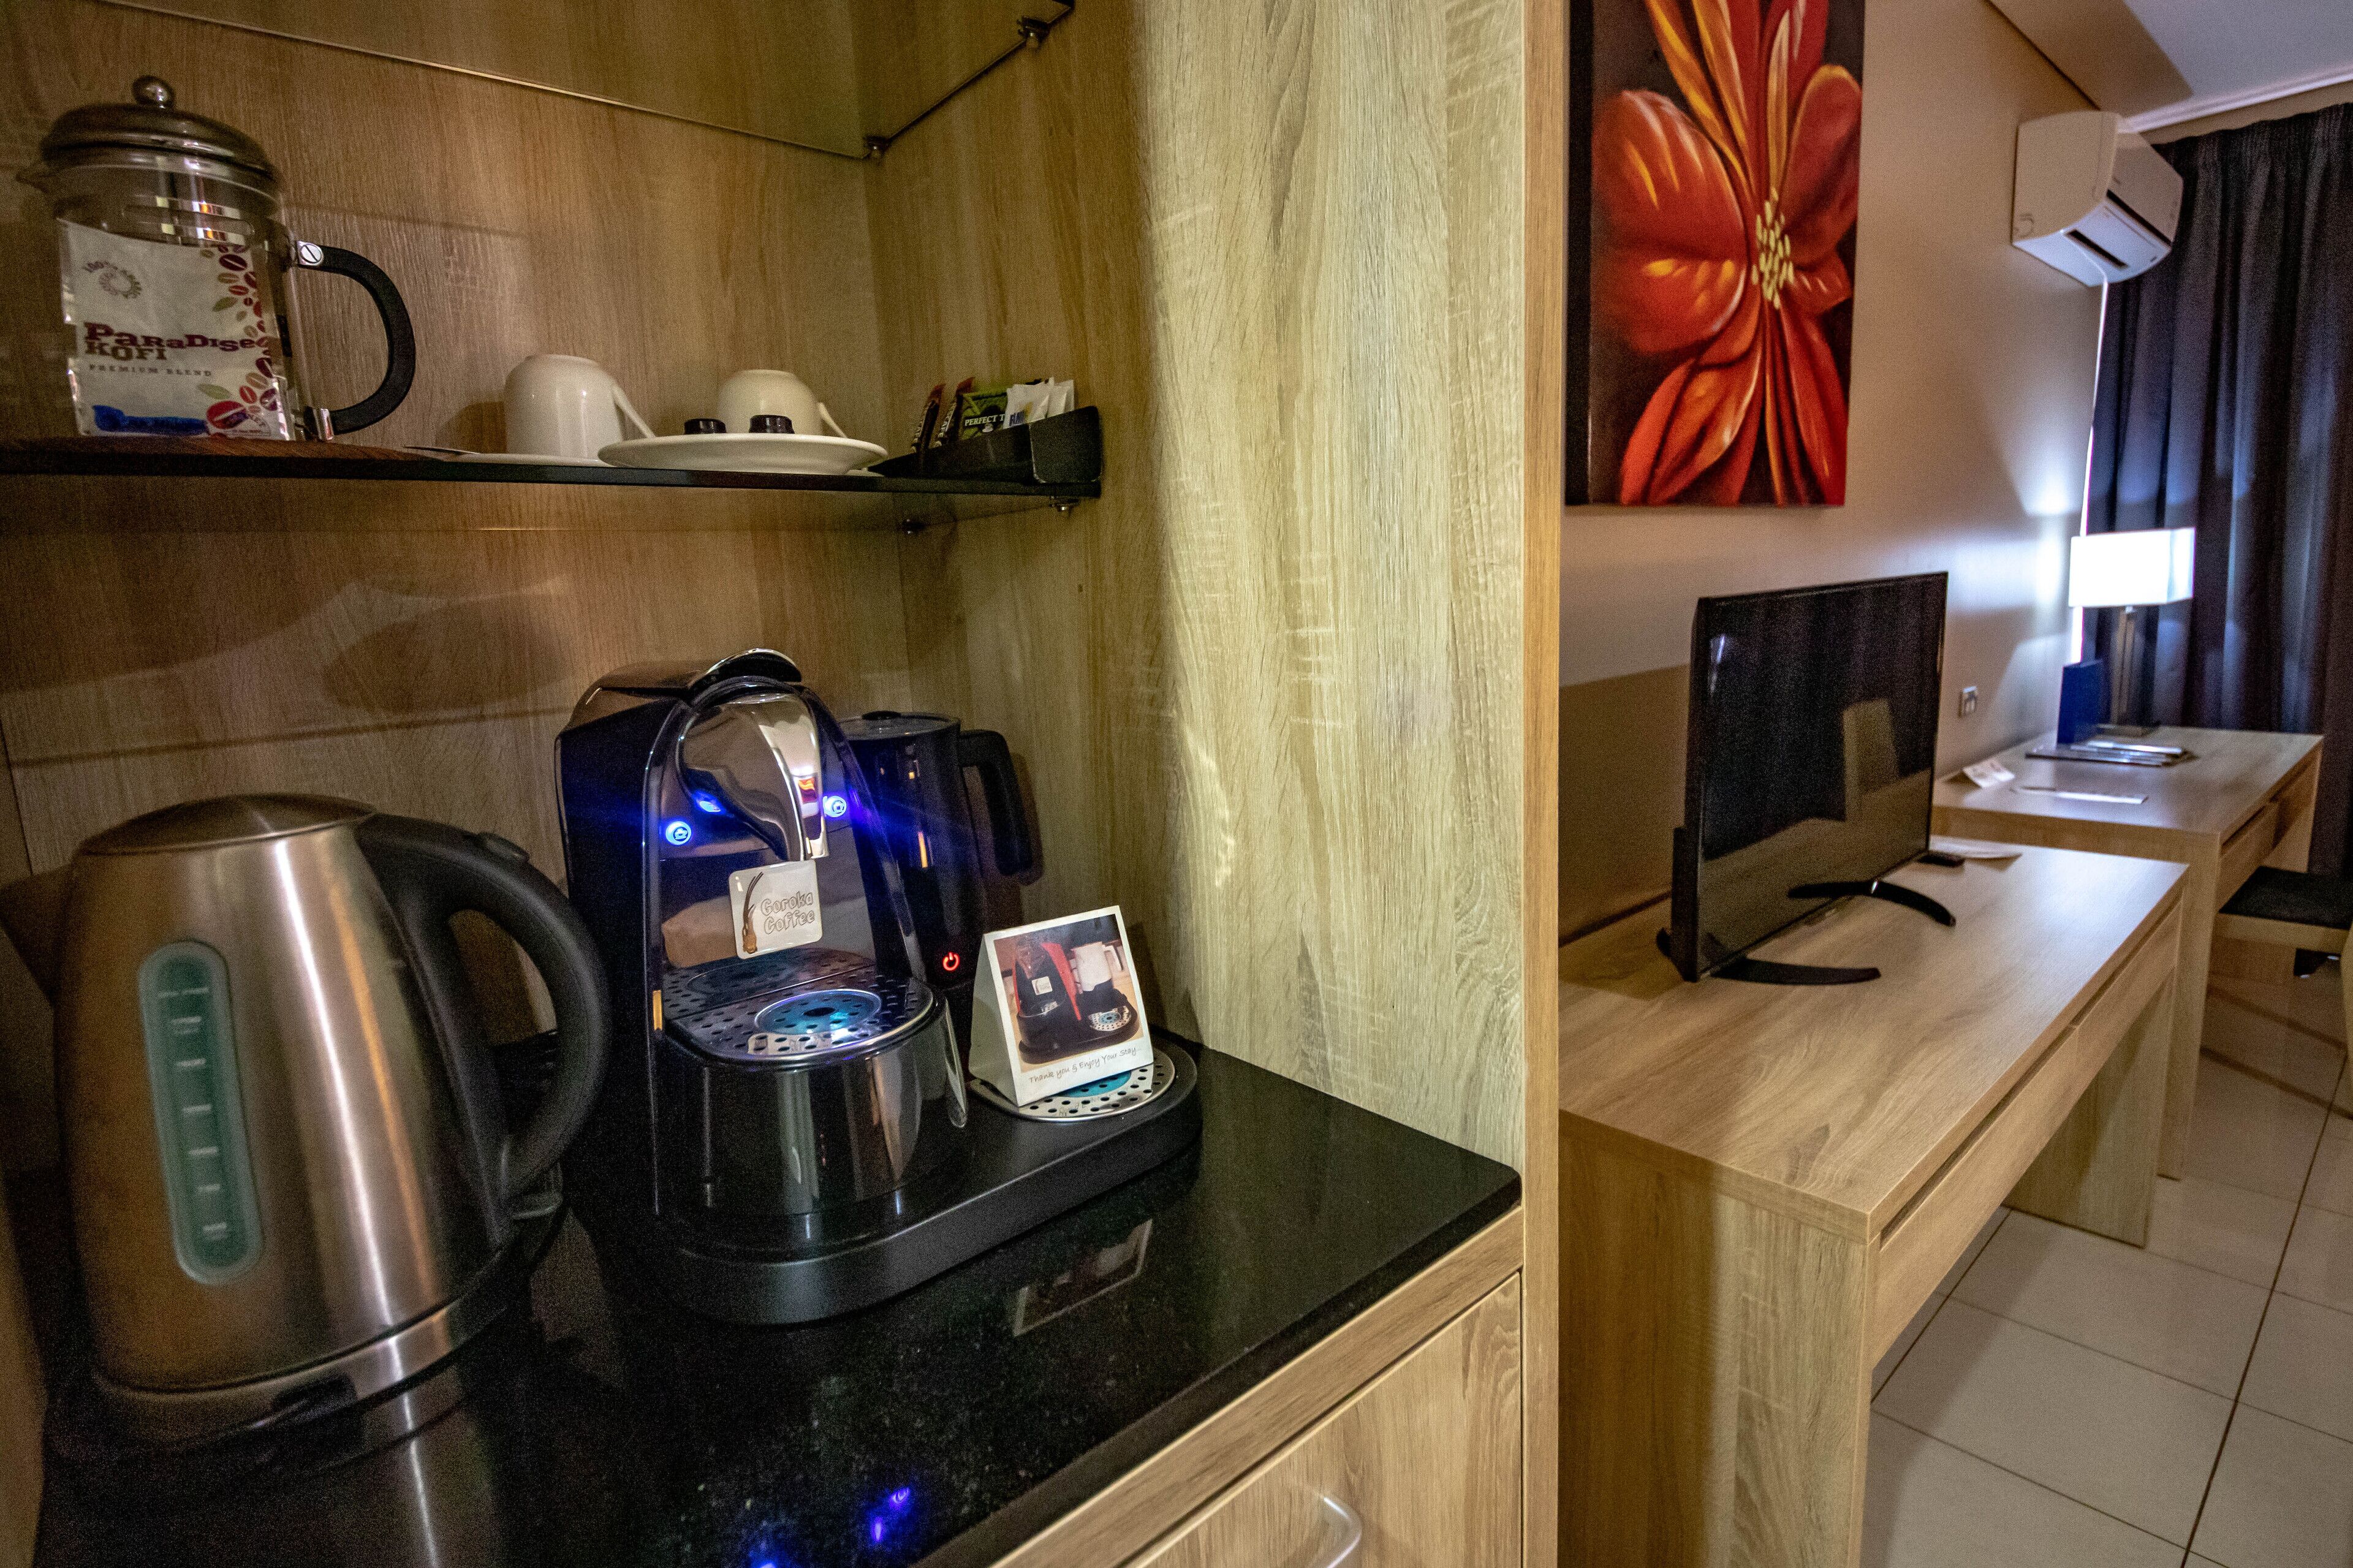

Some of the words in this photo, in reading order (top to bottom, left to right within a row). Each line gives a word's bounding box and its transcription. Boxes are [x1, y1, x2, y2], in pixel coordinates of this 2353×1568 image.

[85, 340, 167, 361] KOFI
[166, 368, 212, 377] BLEND
[965, 415, 998, 426] PERFECT
[760, 891, 814, 916] Goroka
[763, 909, 815, 935] Coffee
[1029, 1070, 1055, 1083] Thank
[1079, 1057, 1101, 1071] Enjoy
[1101, 1053, 1118, 1064] Your
